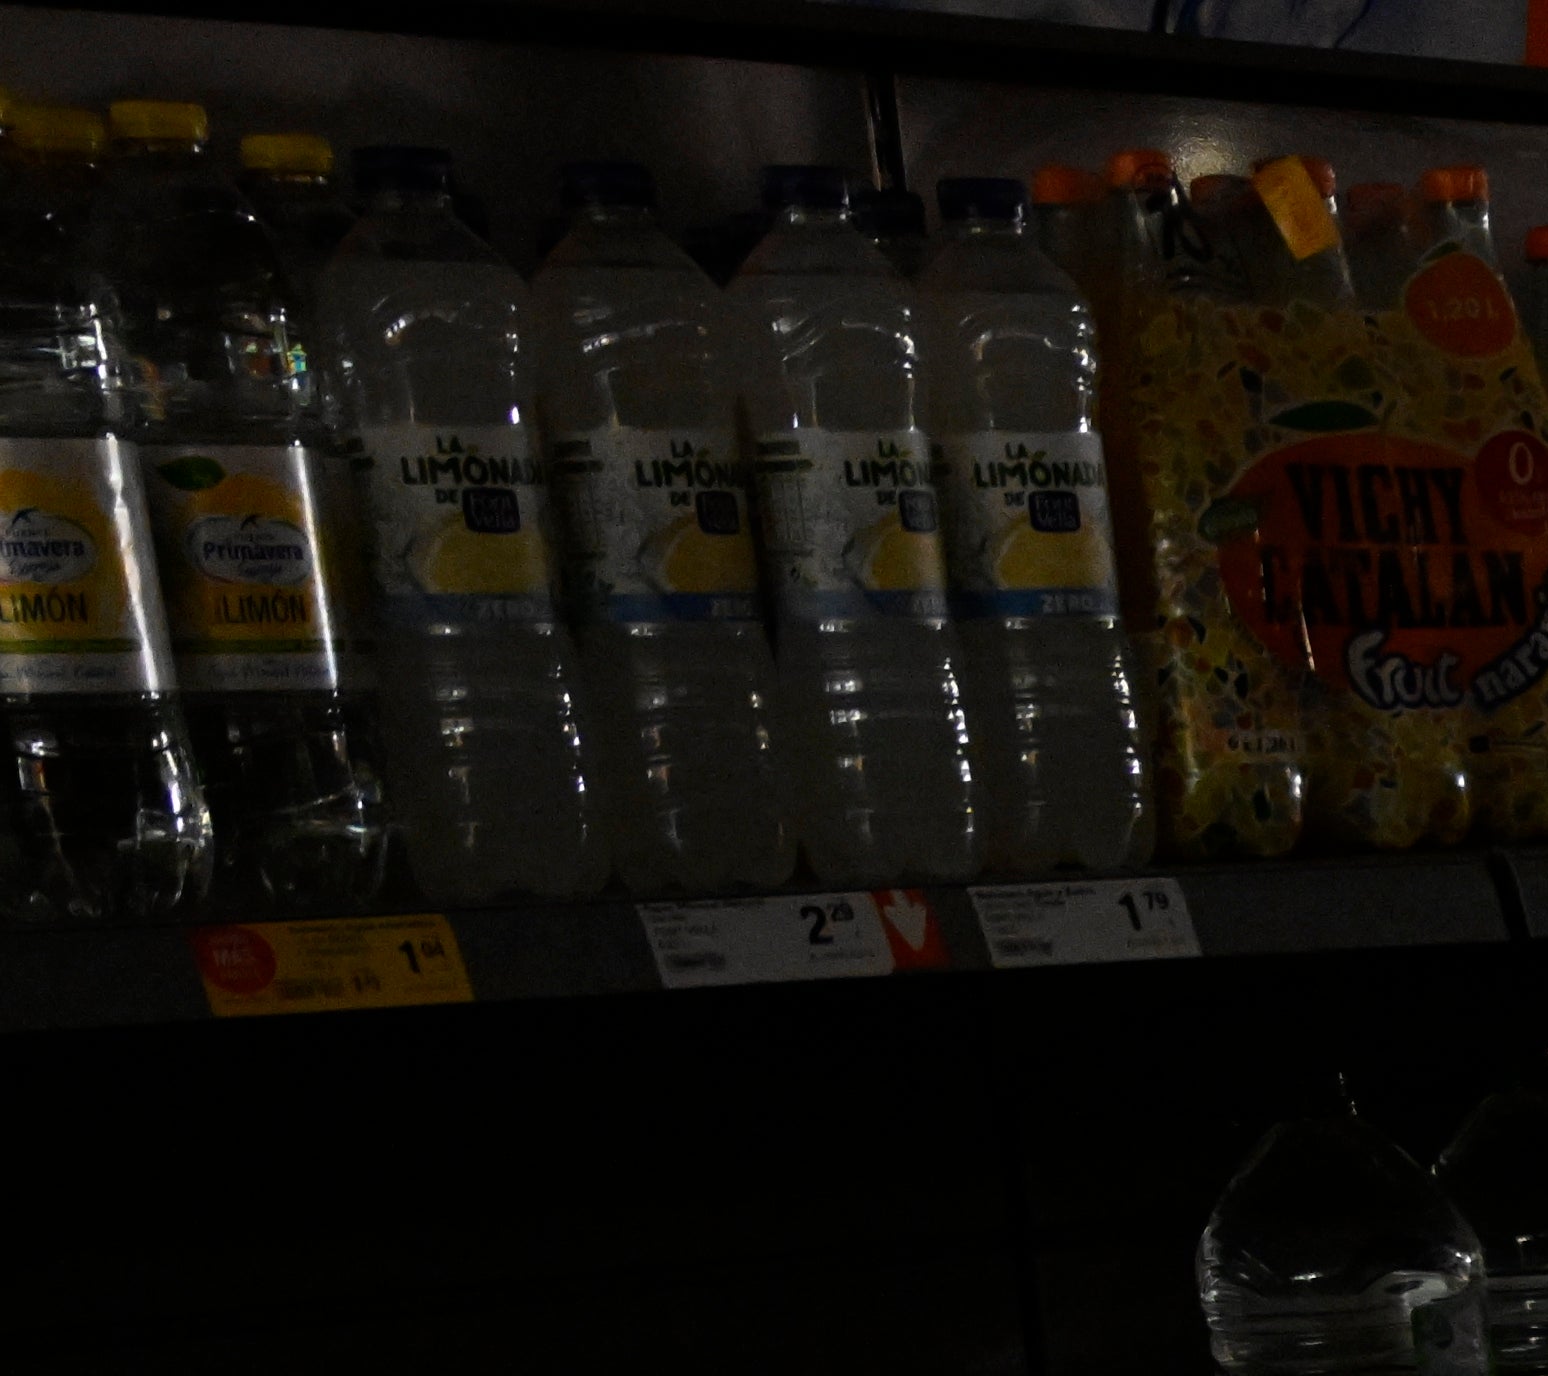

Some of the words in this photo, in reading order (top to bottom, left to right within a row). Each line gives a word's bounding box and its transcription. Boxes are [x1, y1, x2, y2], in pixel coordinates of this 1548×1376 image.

[1508, 441, 1535, 486] 0
[1285, 462, 1465, 544] VICHY
[0, 537, 84, 558] imavera
[202, 538, 304, 562] Primavera
[1260, 546, 1527, 628] CATALAN
